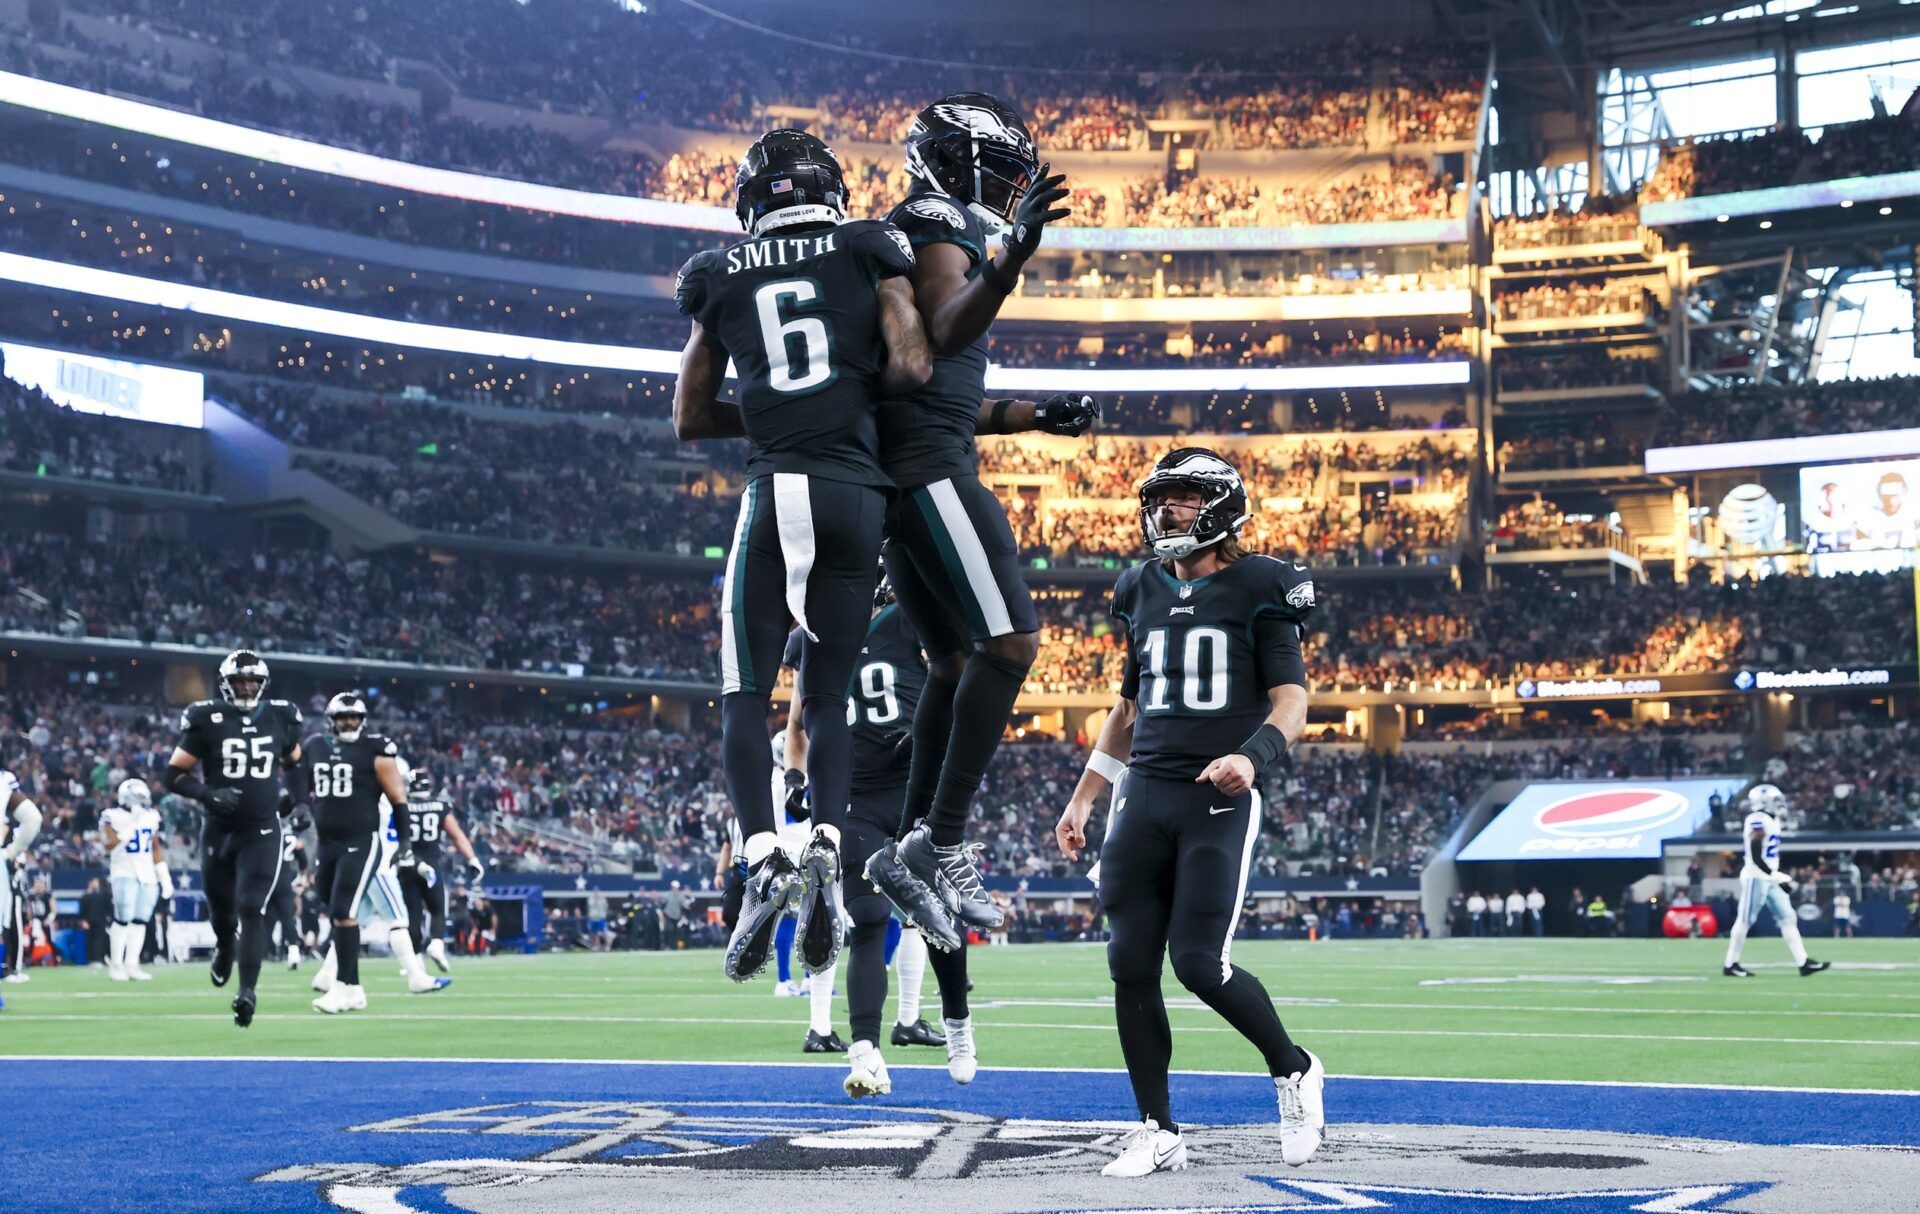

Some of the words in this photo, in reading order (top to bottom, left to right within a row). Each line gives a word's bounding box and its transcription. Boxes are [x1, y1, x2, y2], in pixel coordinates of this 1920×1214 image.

[780, 210, 801, 219] CHOOSE
[802, 207, 816, 215] LOVE
[727, 233, 837, 275] SMITH
[755, 280, 831, 392] 6
[55, 358, 143, 416] LOUDER
[1169, 605, 1195, 616] EAGLES
[1143, 628, 1228, 711] 10
[221, 736, 274, 779] 65
[313, 762, 353, 798] 68
[1519, 834, 1643, 854] pepsi
